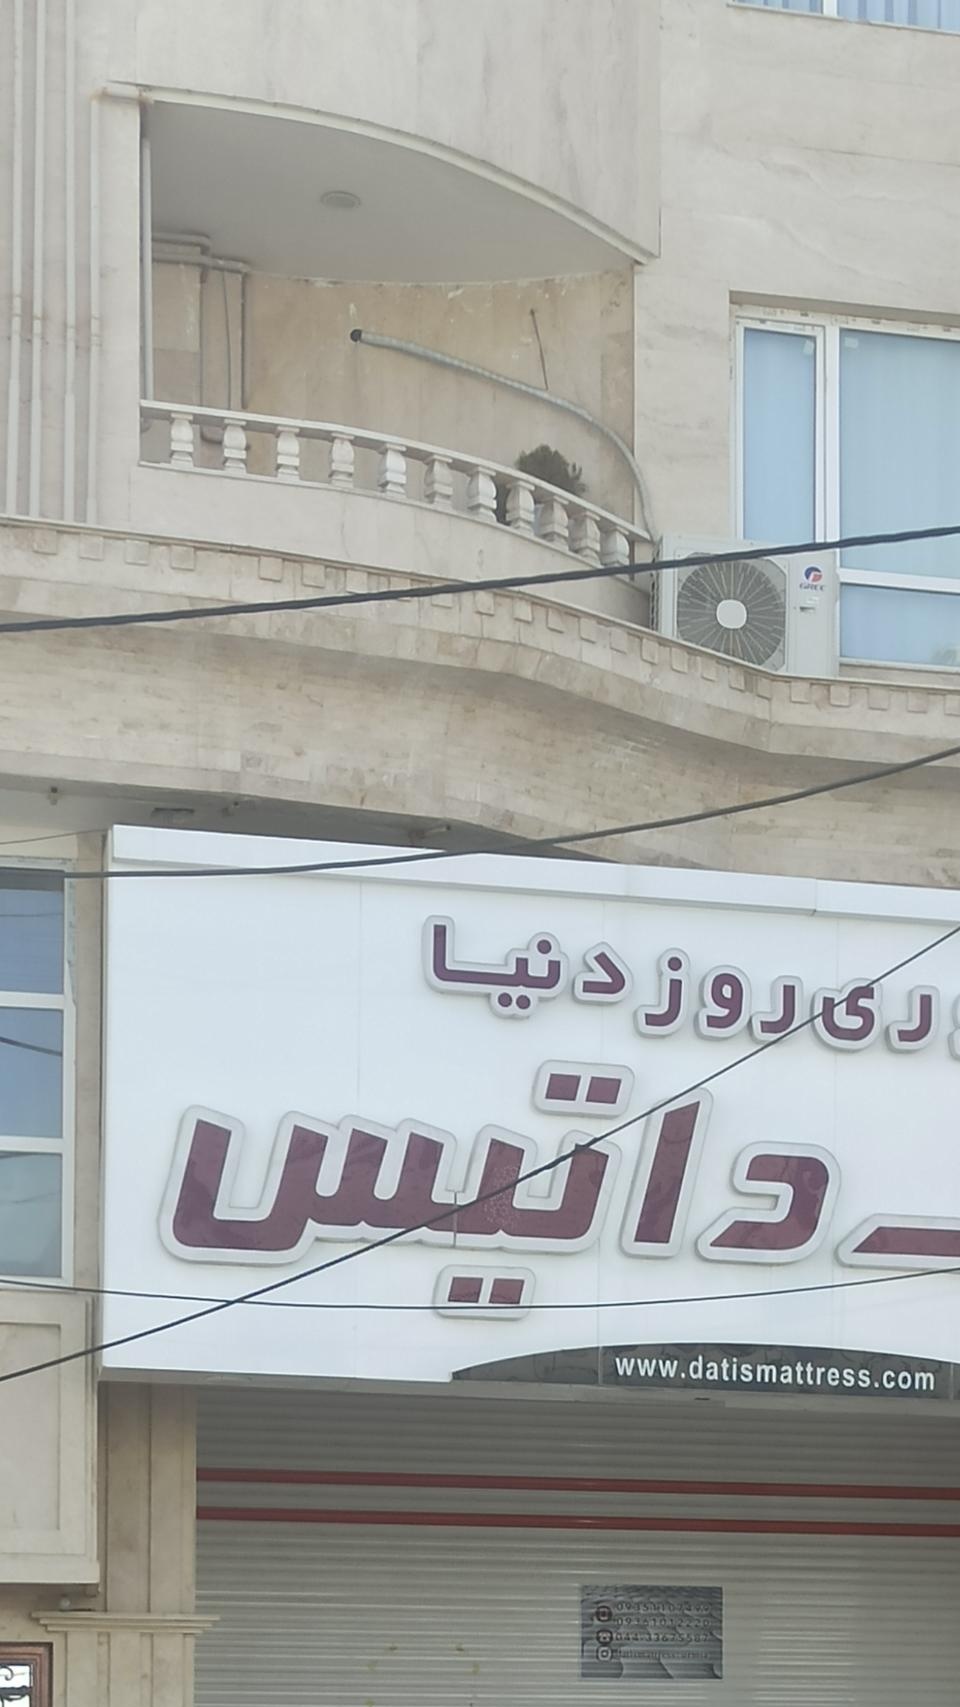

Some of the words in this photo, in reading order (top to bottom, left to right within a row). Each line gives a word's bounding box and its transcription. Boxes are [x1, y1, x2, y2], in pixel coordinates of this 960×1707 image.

[431, 922, 627, 1011] دنیا
[644, 955, 797, 1035] روز
[171, 1072, 831, 1306] داتیس
[614, 1354, 936, 1391] www.datismattress.com
